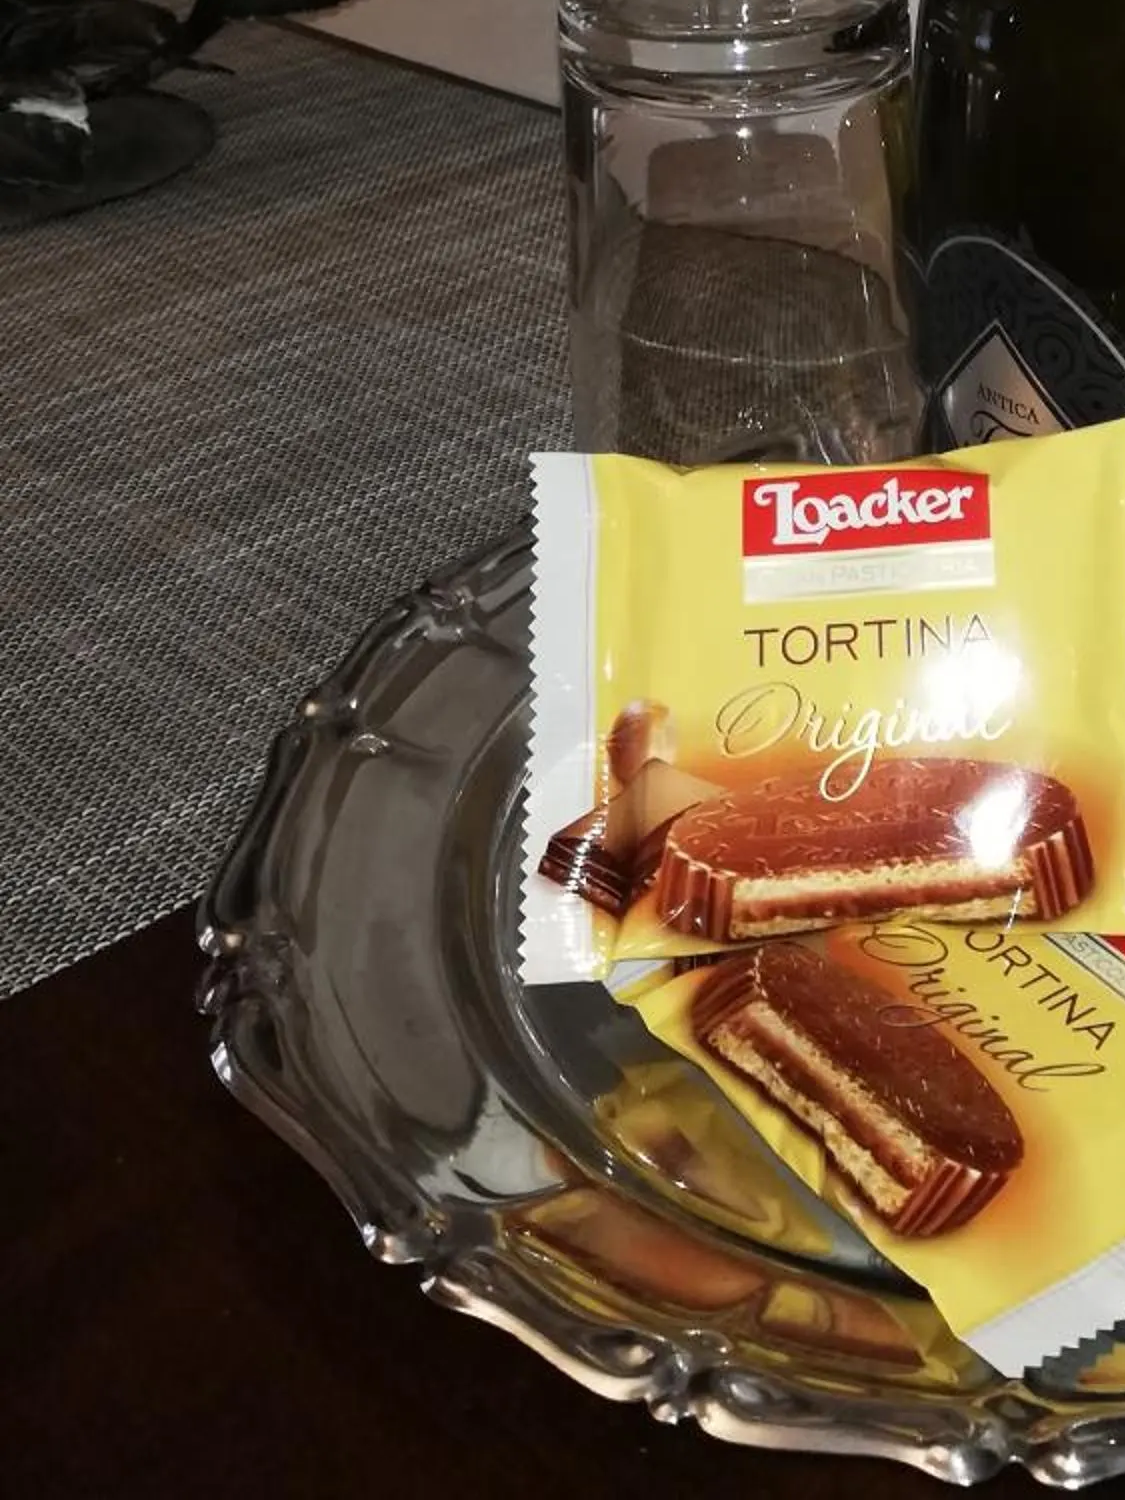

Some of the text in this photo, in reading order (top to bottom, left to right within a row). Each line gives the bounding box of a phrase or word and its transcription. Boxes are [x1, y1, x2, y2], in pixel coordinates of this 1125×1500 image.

[976, 383, 1040, 425] ANTICA
[752, 477, 975, 545] Loacker
[744, 613, 991, 668] TORTINA
[859, 924, 1106, 1092] Original
[964, 929, 1117, 1051] ORTINA
